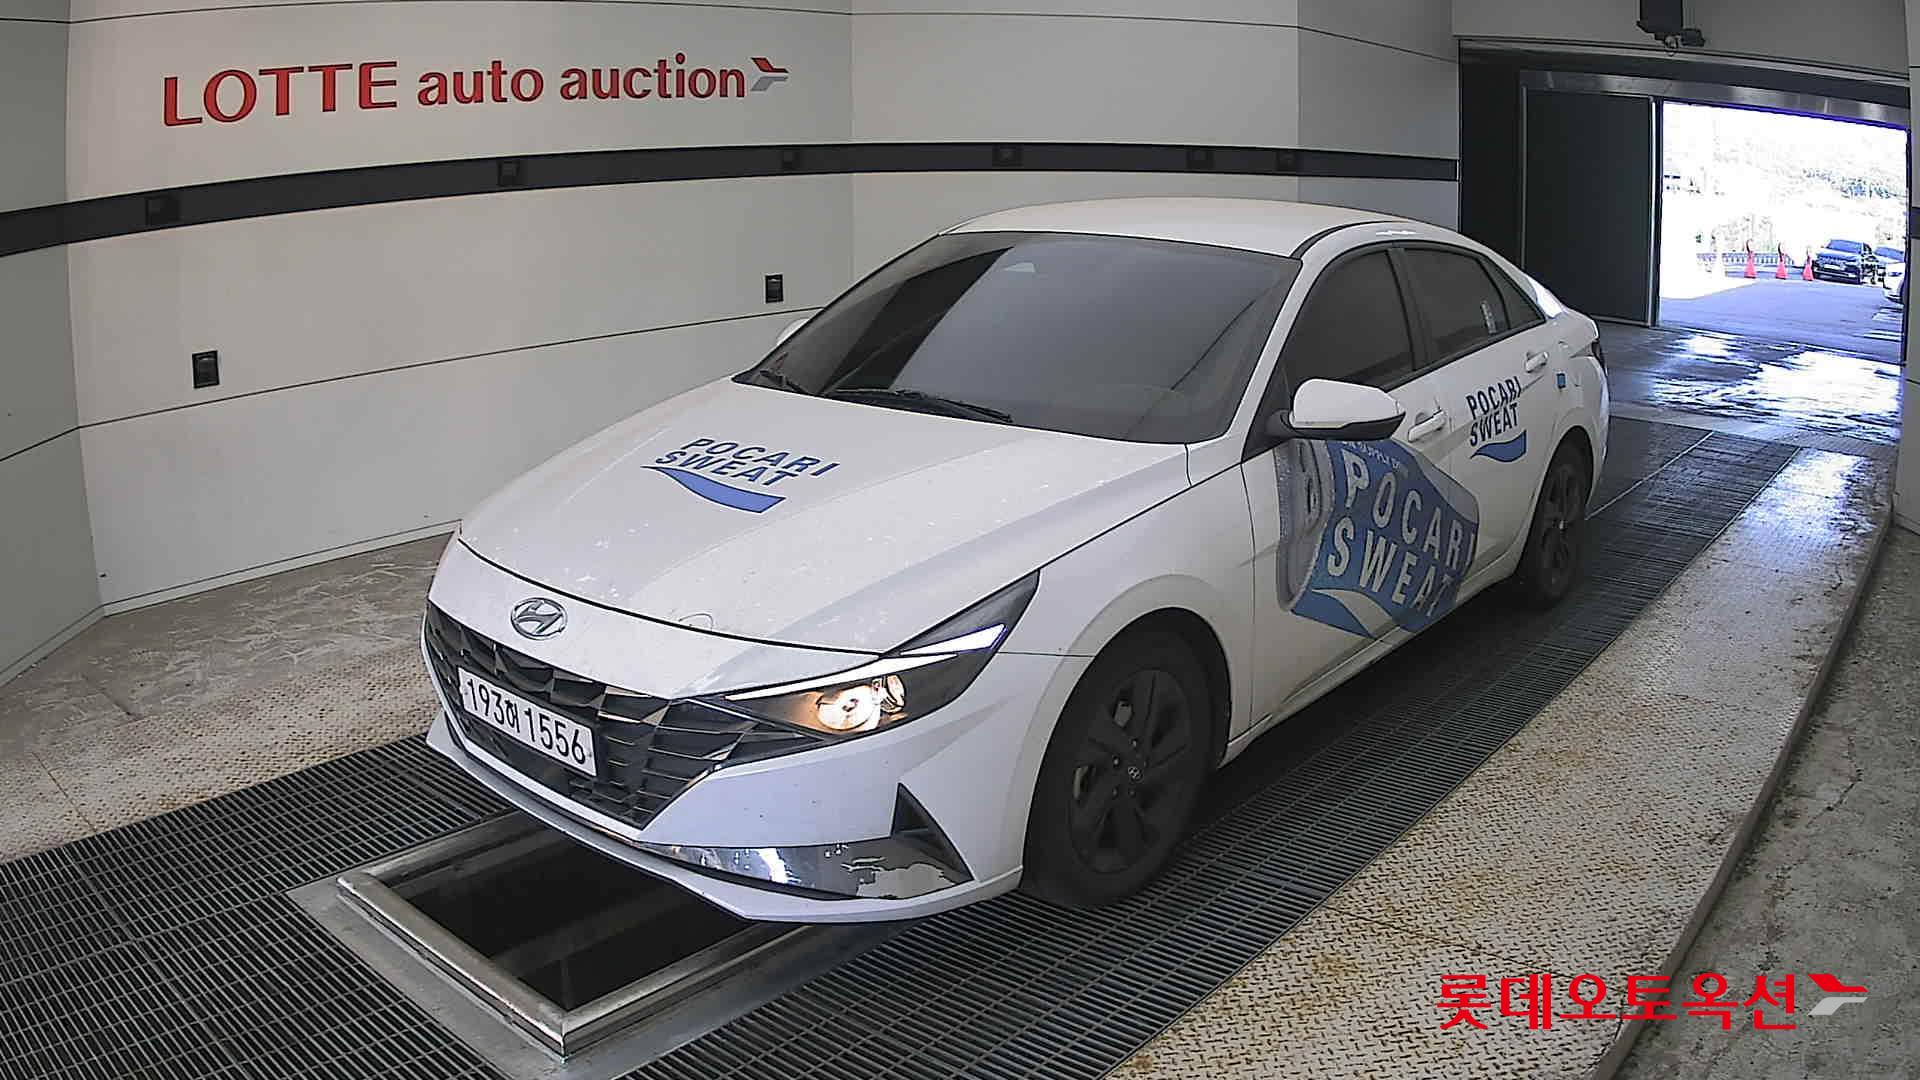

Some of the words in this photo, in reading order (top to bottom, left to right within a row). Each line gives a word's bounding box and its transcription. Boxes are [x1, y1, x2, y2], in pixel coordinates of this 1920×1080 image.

[163, 60, 398, 127] LOTTE
[416, 59, 544, 106] auto
[559, 52, 746, 101] auction
[1465, 376, 1522, 420] POCARI
[1469, 402, 1518, 447] SWEAT
[655, 451, 798, 486] SWEAT
[681, 438, 840, 476] POCARI
[1341, 448, 1476, 571] POCARI
[1327, 516, 1456, 617] SWEAT
[524, 708, 586, 765] 1556
